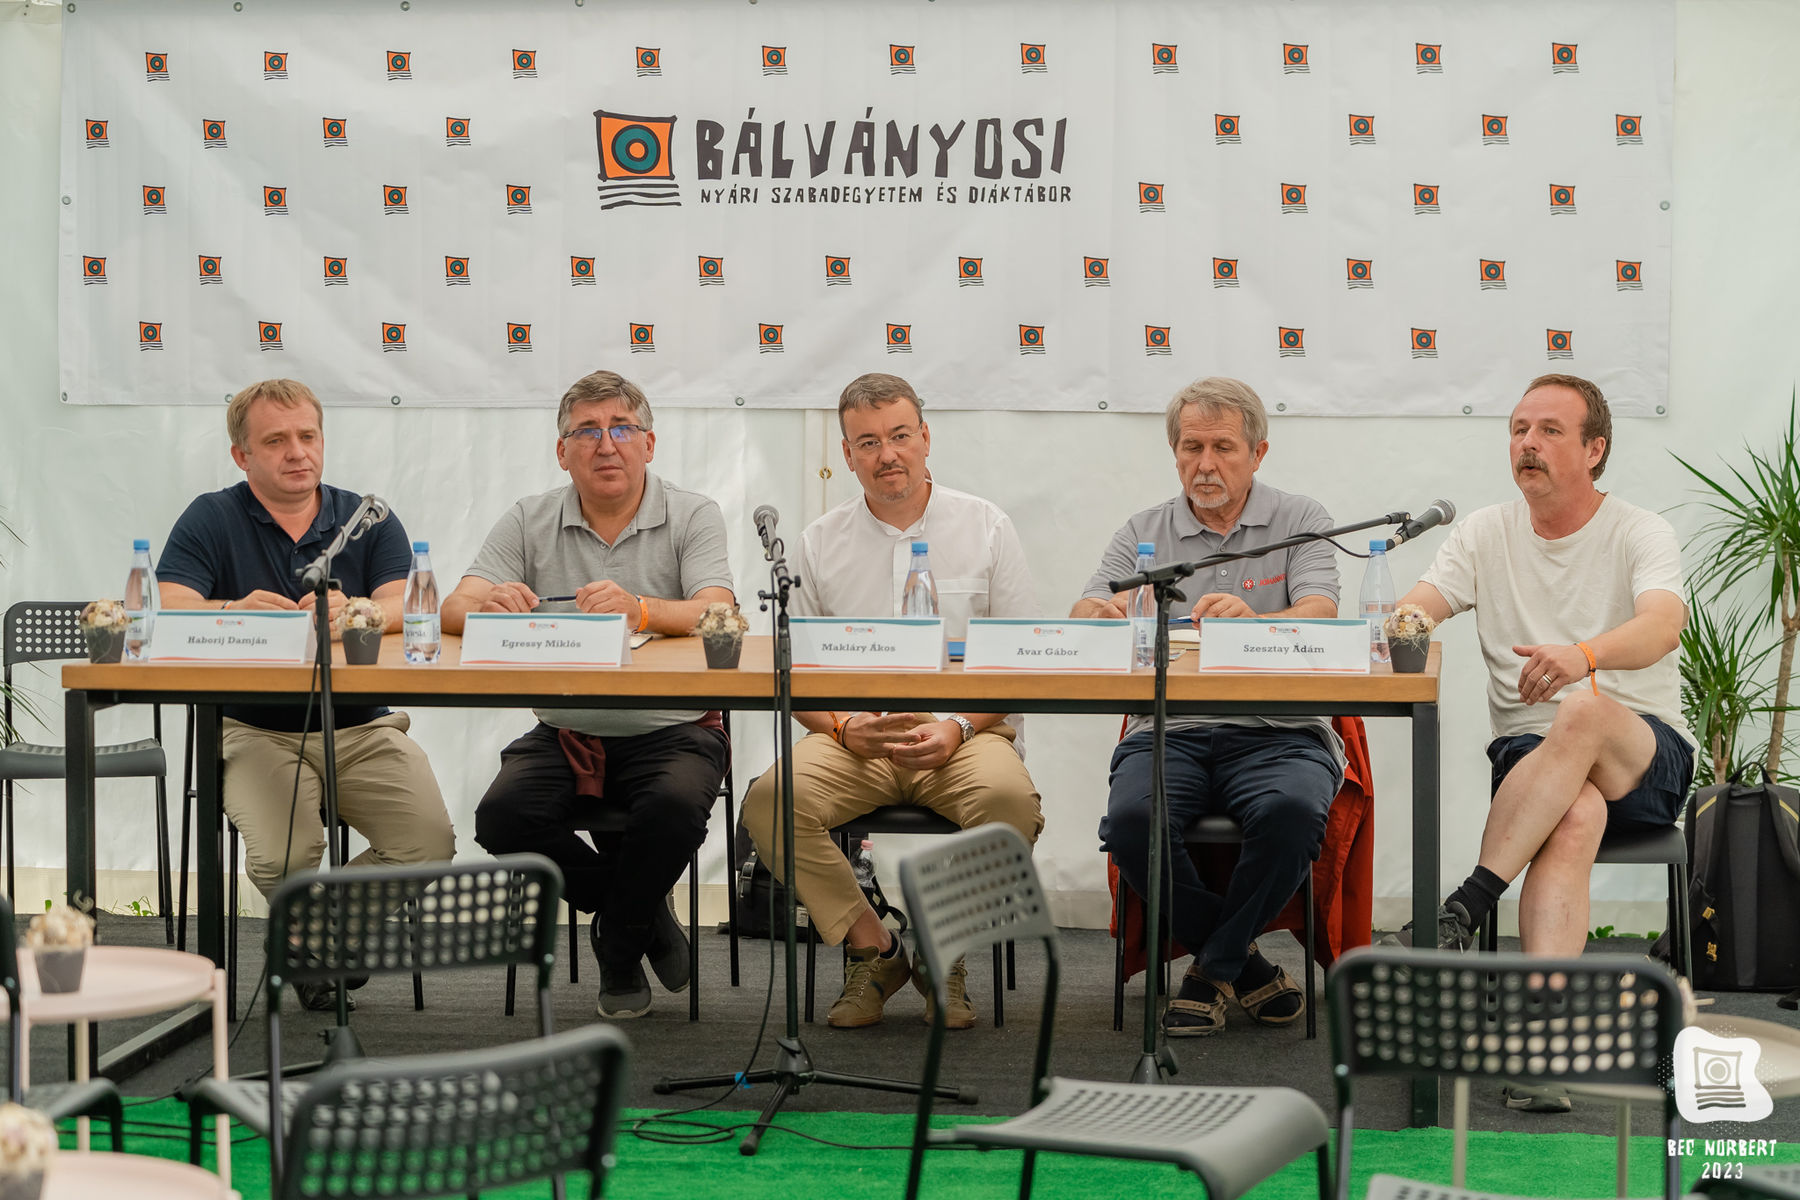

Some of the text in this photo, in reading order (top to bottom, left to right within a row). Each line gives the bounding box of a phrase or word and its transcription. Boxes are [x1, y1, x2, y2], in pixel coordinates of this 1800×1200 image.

[696, 107, 1067, 180] BÁLVÁNYOSI
[701, 182, 1071, 204] NYÁRI SZABADEGYETEM ÉS DIÁKTÁBOR
[187, 635, 267, 645] Haborij Damján
[501, 638, 581, 649] Egressy Miklós
[821, 642, 896, 653] Makláry Ákos
[1016, 646, 1079, 656] Avar Gábor
[1243, 642, 1325, 654] Szesztay Ádám
